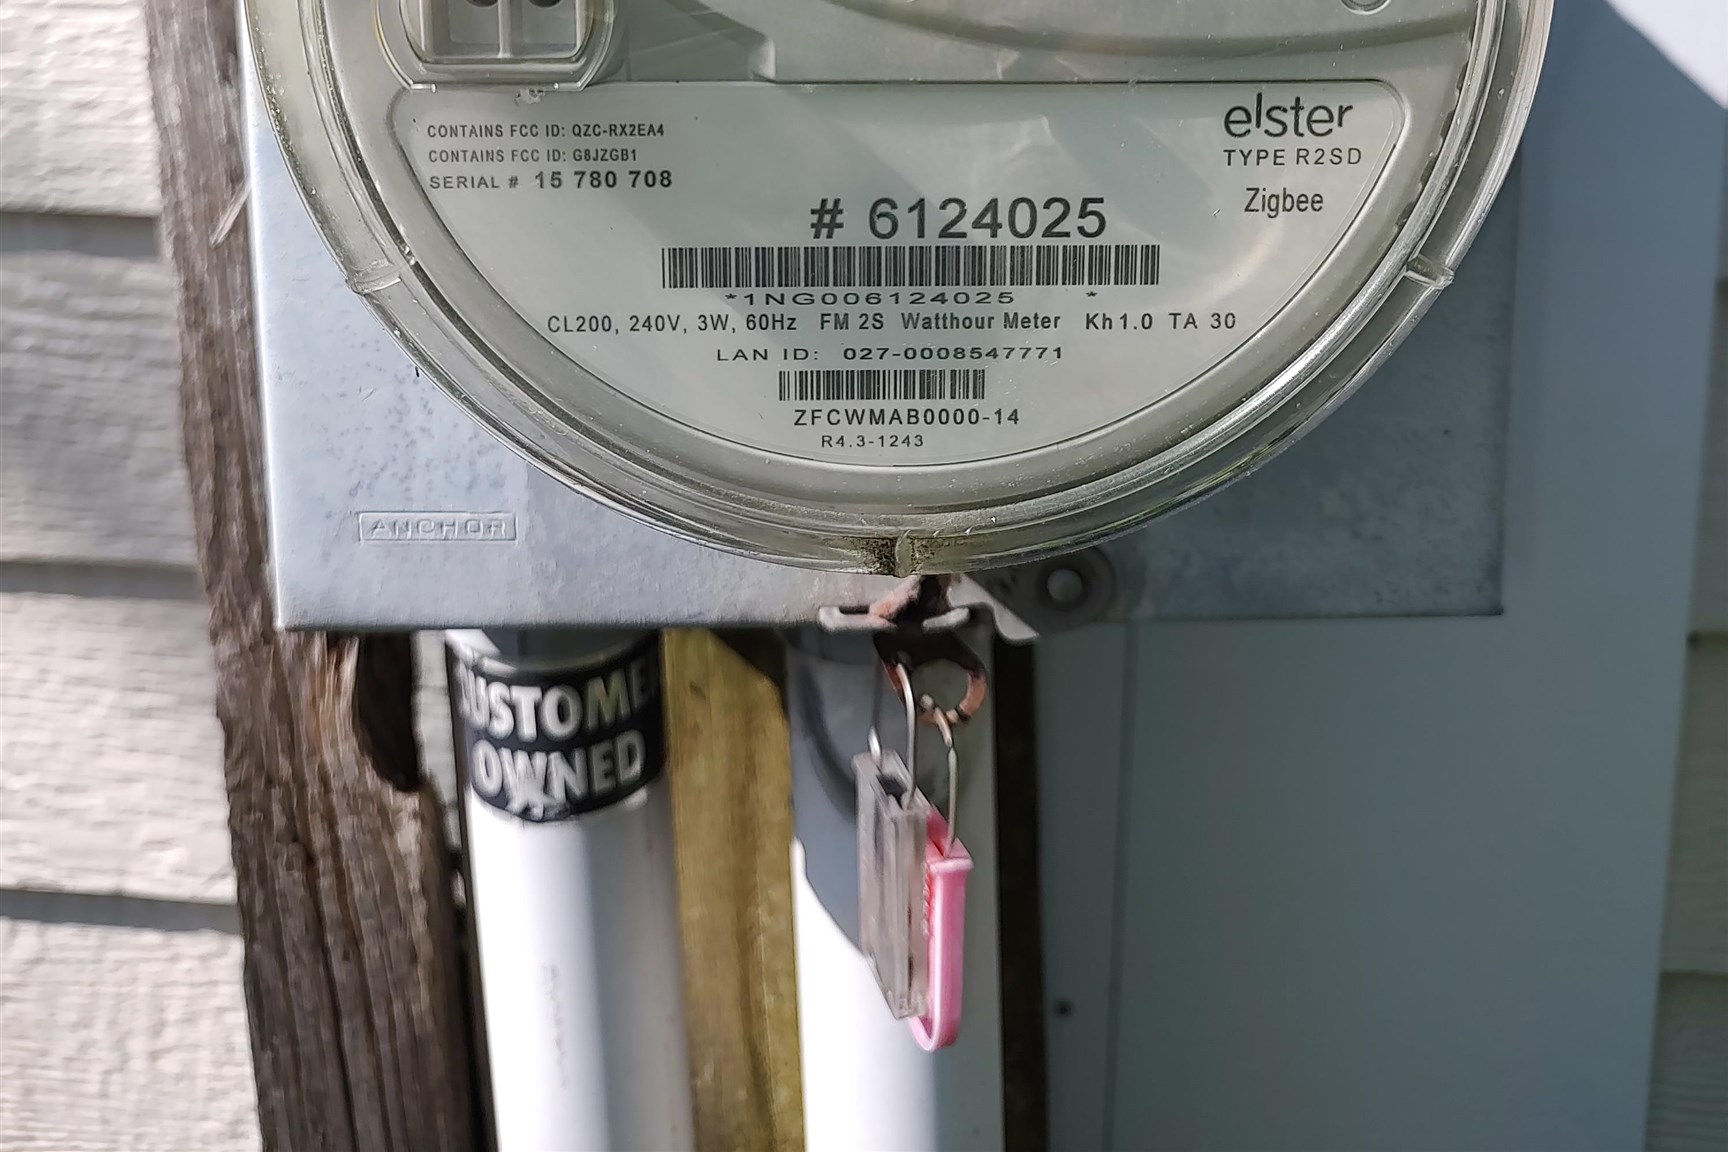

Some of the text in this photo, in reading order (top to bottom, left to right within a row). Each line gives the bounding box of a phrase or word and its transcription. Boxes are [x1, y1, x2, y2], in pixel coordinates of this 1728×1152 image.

[1224, 92, 1354, 138] elster
[427, 123, 665, 138] CONTAINS FCC ID: QZC-RX2EA4
[428, 148, 638, 163] CONTAINS FCC ID: G8JZGB1
[1222, 147, 1362, 166] TYPE R2SD
[429, 170, 673, 189] SERIAL # 15 780 708
[1244, 186, 1324, 219] Zigbee
[810, 197, 1107, 239] # 6124025
[547, 314, 619, 335] CL200,
[628, 314, 688, 334] 240V,
[697, 313, 736, 334] 3W,
[745, 312, 798, 330] 60Hz
[819, 312, 850, 330] FM
[857, 311, 885, 330] 2S
[900, 311, 996, 329] Watthour
[1003, 311, 1062, 329] Meter
[1168, 312, 1199, 329] TA
[1210, 312, 1237, 329] 30
[716, 346, 1062, 361] LAN ID: 027-0008547771
[793, 407, 1020, 426] ZFCWMAB0000-14
[821, 434, 924, 448] R4.3-1243
[369, 518, 506, 539] ANCHOR
[472, 728, 647, 808] OWNED
